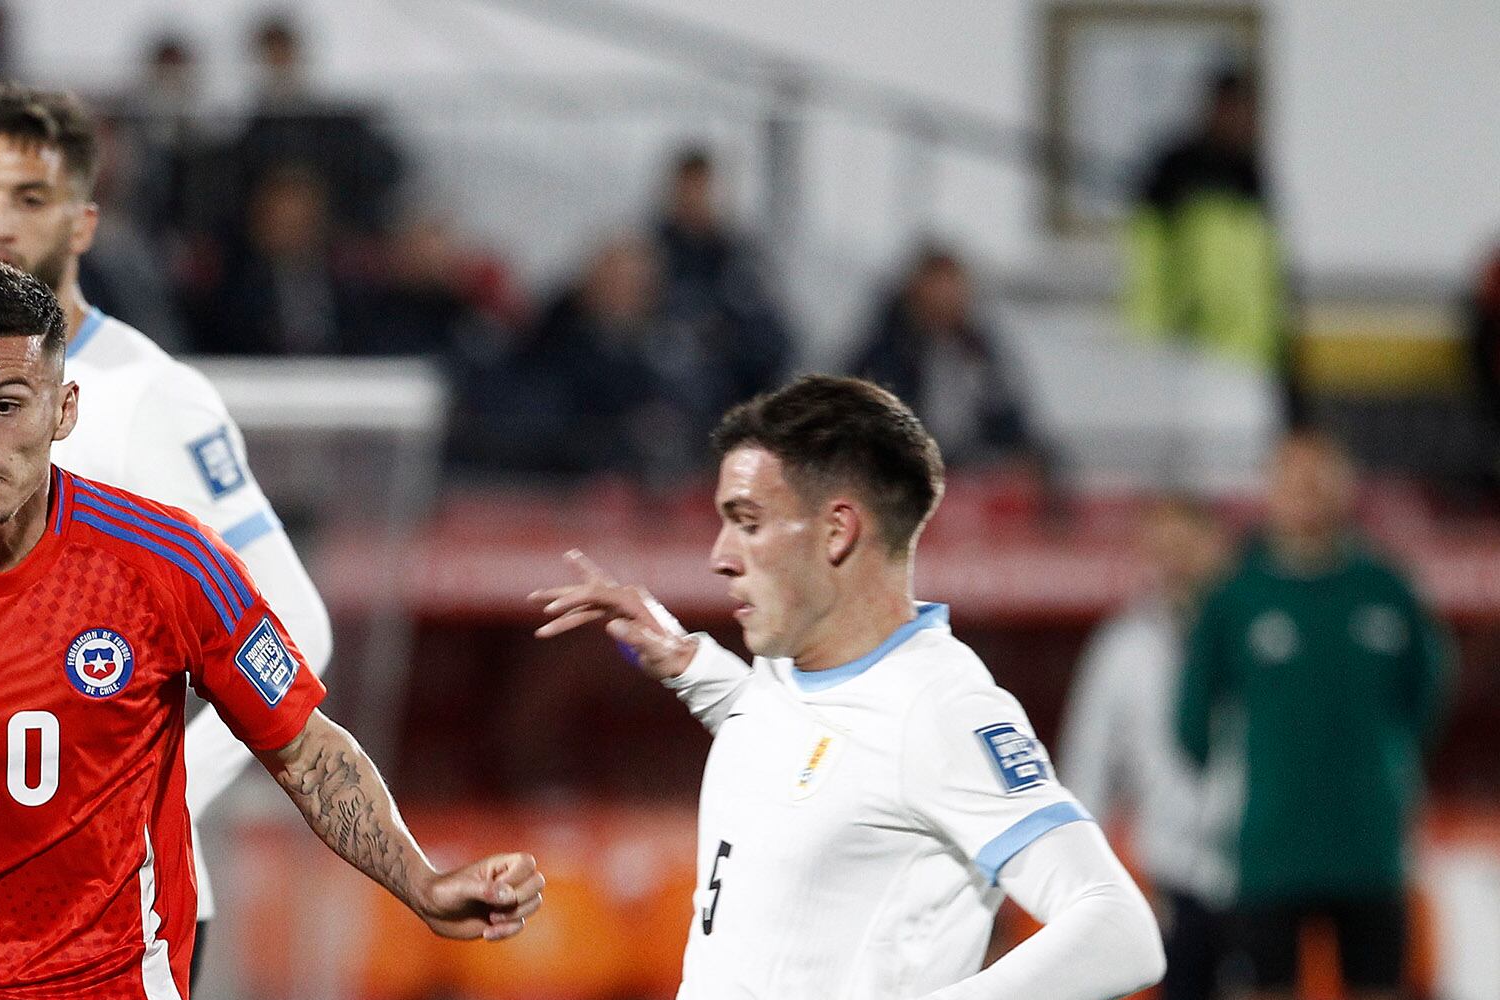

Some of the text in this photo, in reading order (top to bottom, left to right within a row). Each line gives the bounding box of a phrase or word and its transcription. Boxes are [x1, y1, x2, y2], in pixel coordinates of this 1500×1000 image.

[102, 631, 113, 641] DE
[245, 632, 272, 663] FOOTBALL
[251, 638, 278, 673] UNITES
[85, 683, 120, 696] DE CHILE
[702, 840, 732, 936] 5
